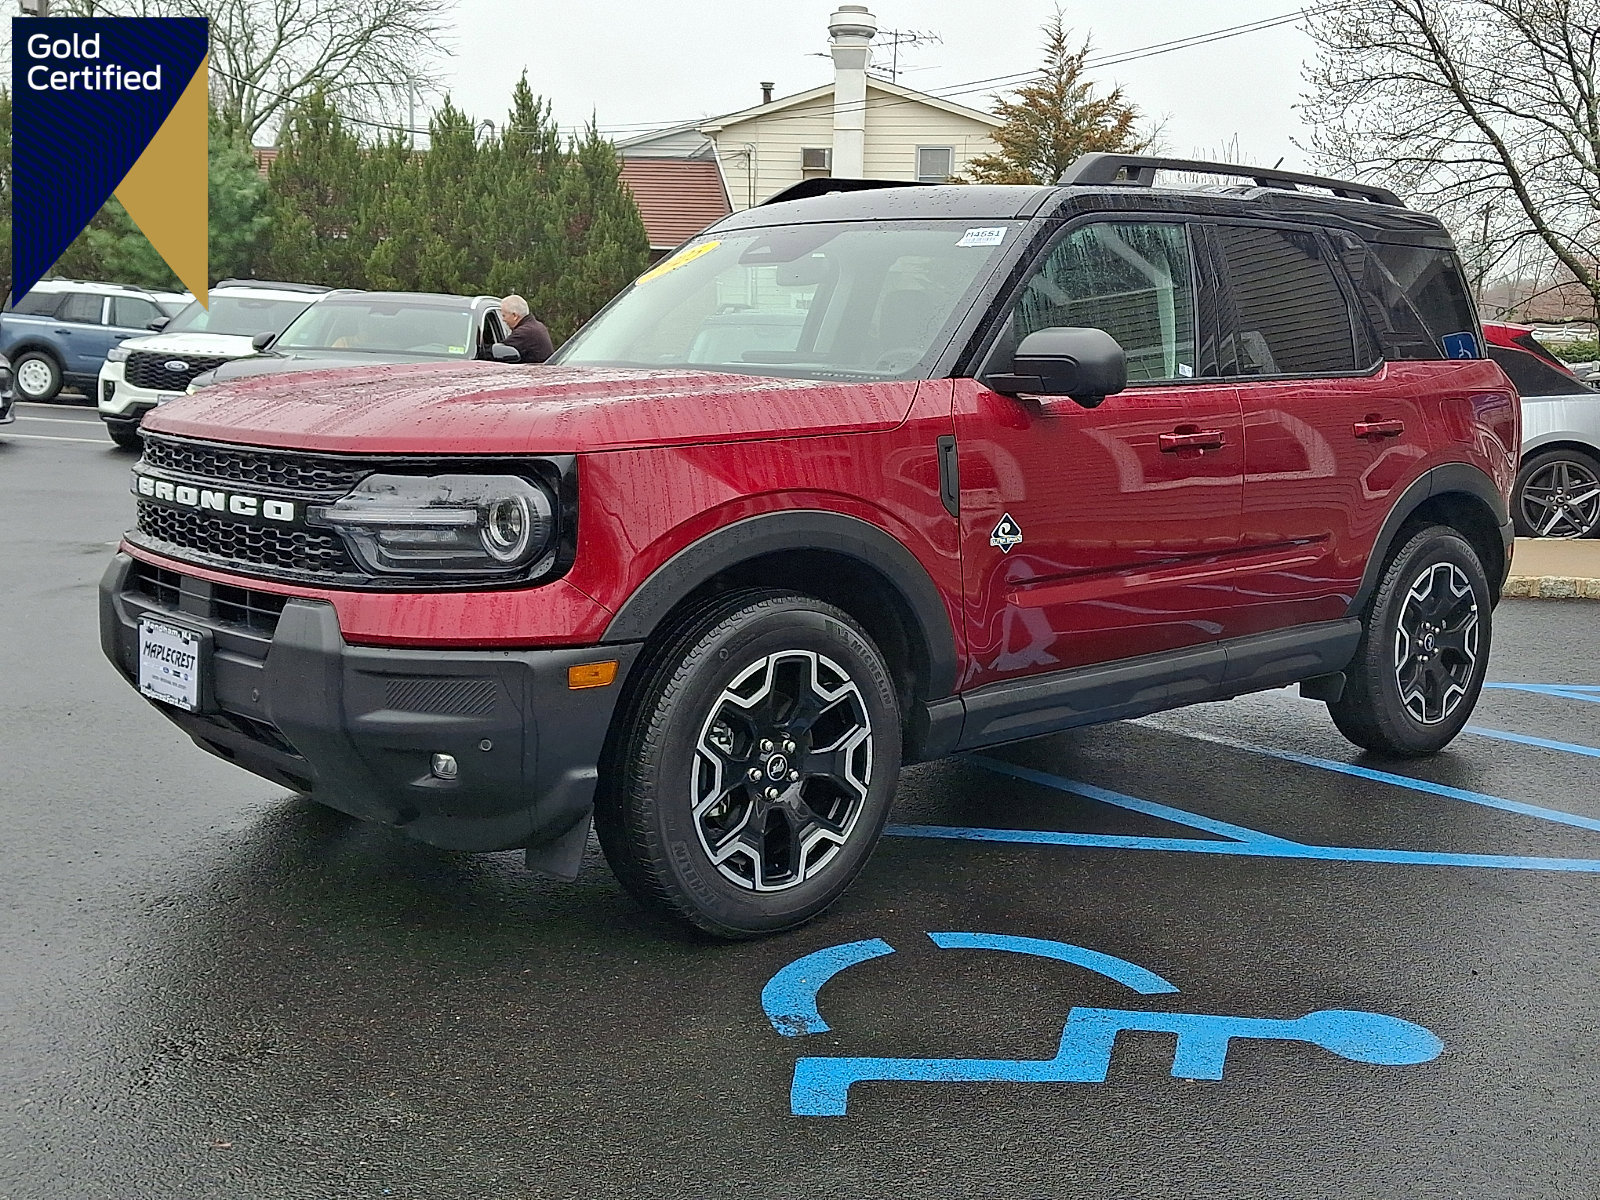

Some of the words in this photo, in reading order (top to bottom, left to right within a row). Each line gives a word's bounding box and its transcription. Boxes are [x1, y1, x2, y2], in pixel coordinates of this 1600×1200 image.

[138, 476, 295, 522] BRONCO
[142, 640, 196, 671] MAPLECREST
[850, 640, 893, 705] MICHELIN
